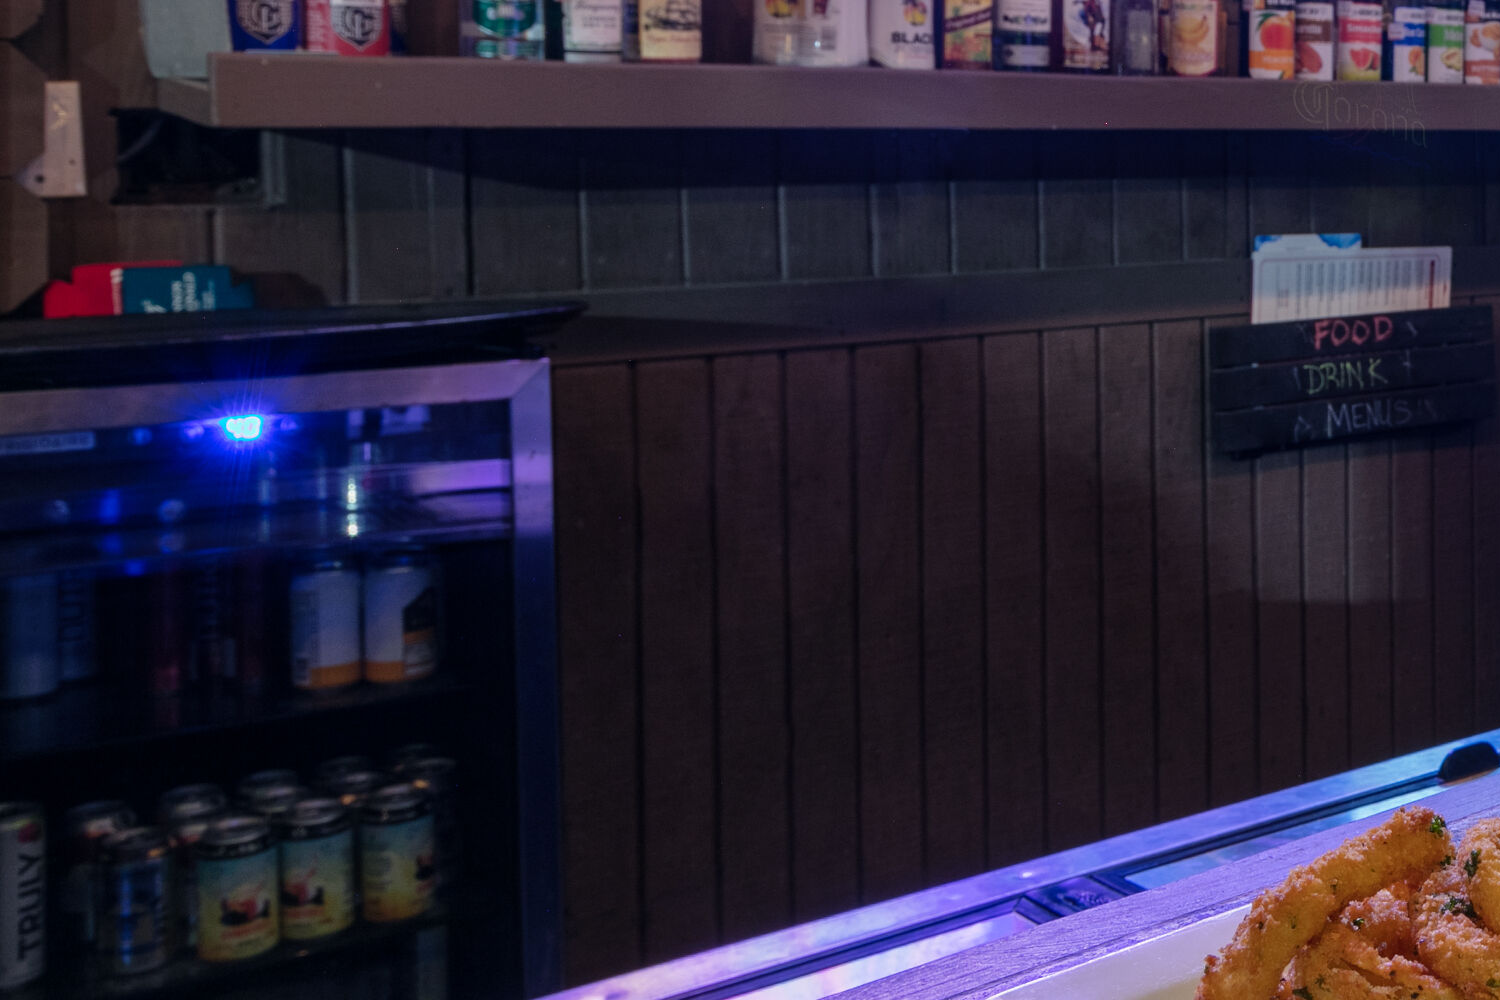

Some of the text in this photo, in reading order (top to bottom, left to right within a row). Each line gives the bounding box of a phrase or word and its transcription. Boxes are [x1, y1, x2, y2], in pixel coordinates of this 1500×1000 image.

[891, 32, 932, 44] BLAC
[1313, 315, 1394, 350] FOOD
[1303, 358, 1388, 395] DRINK
[1326, 399, 1412, 438] MENUS
[16, 852, 41, 961] TRULY
